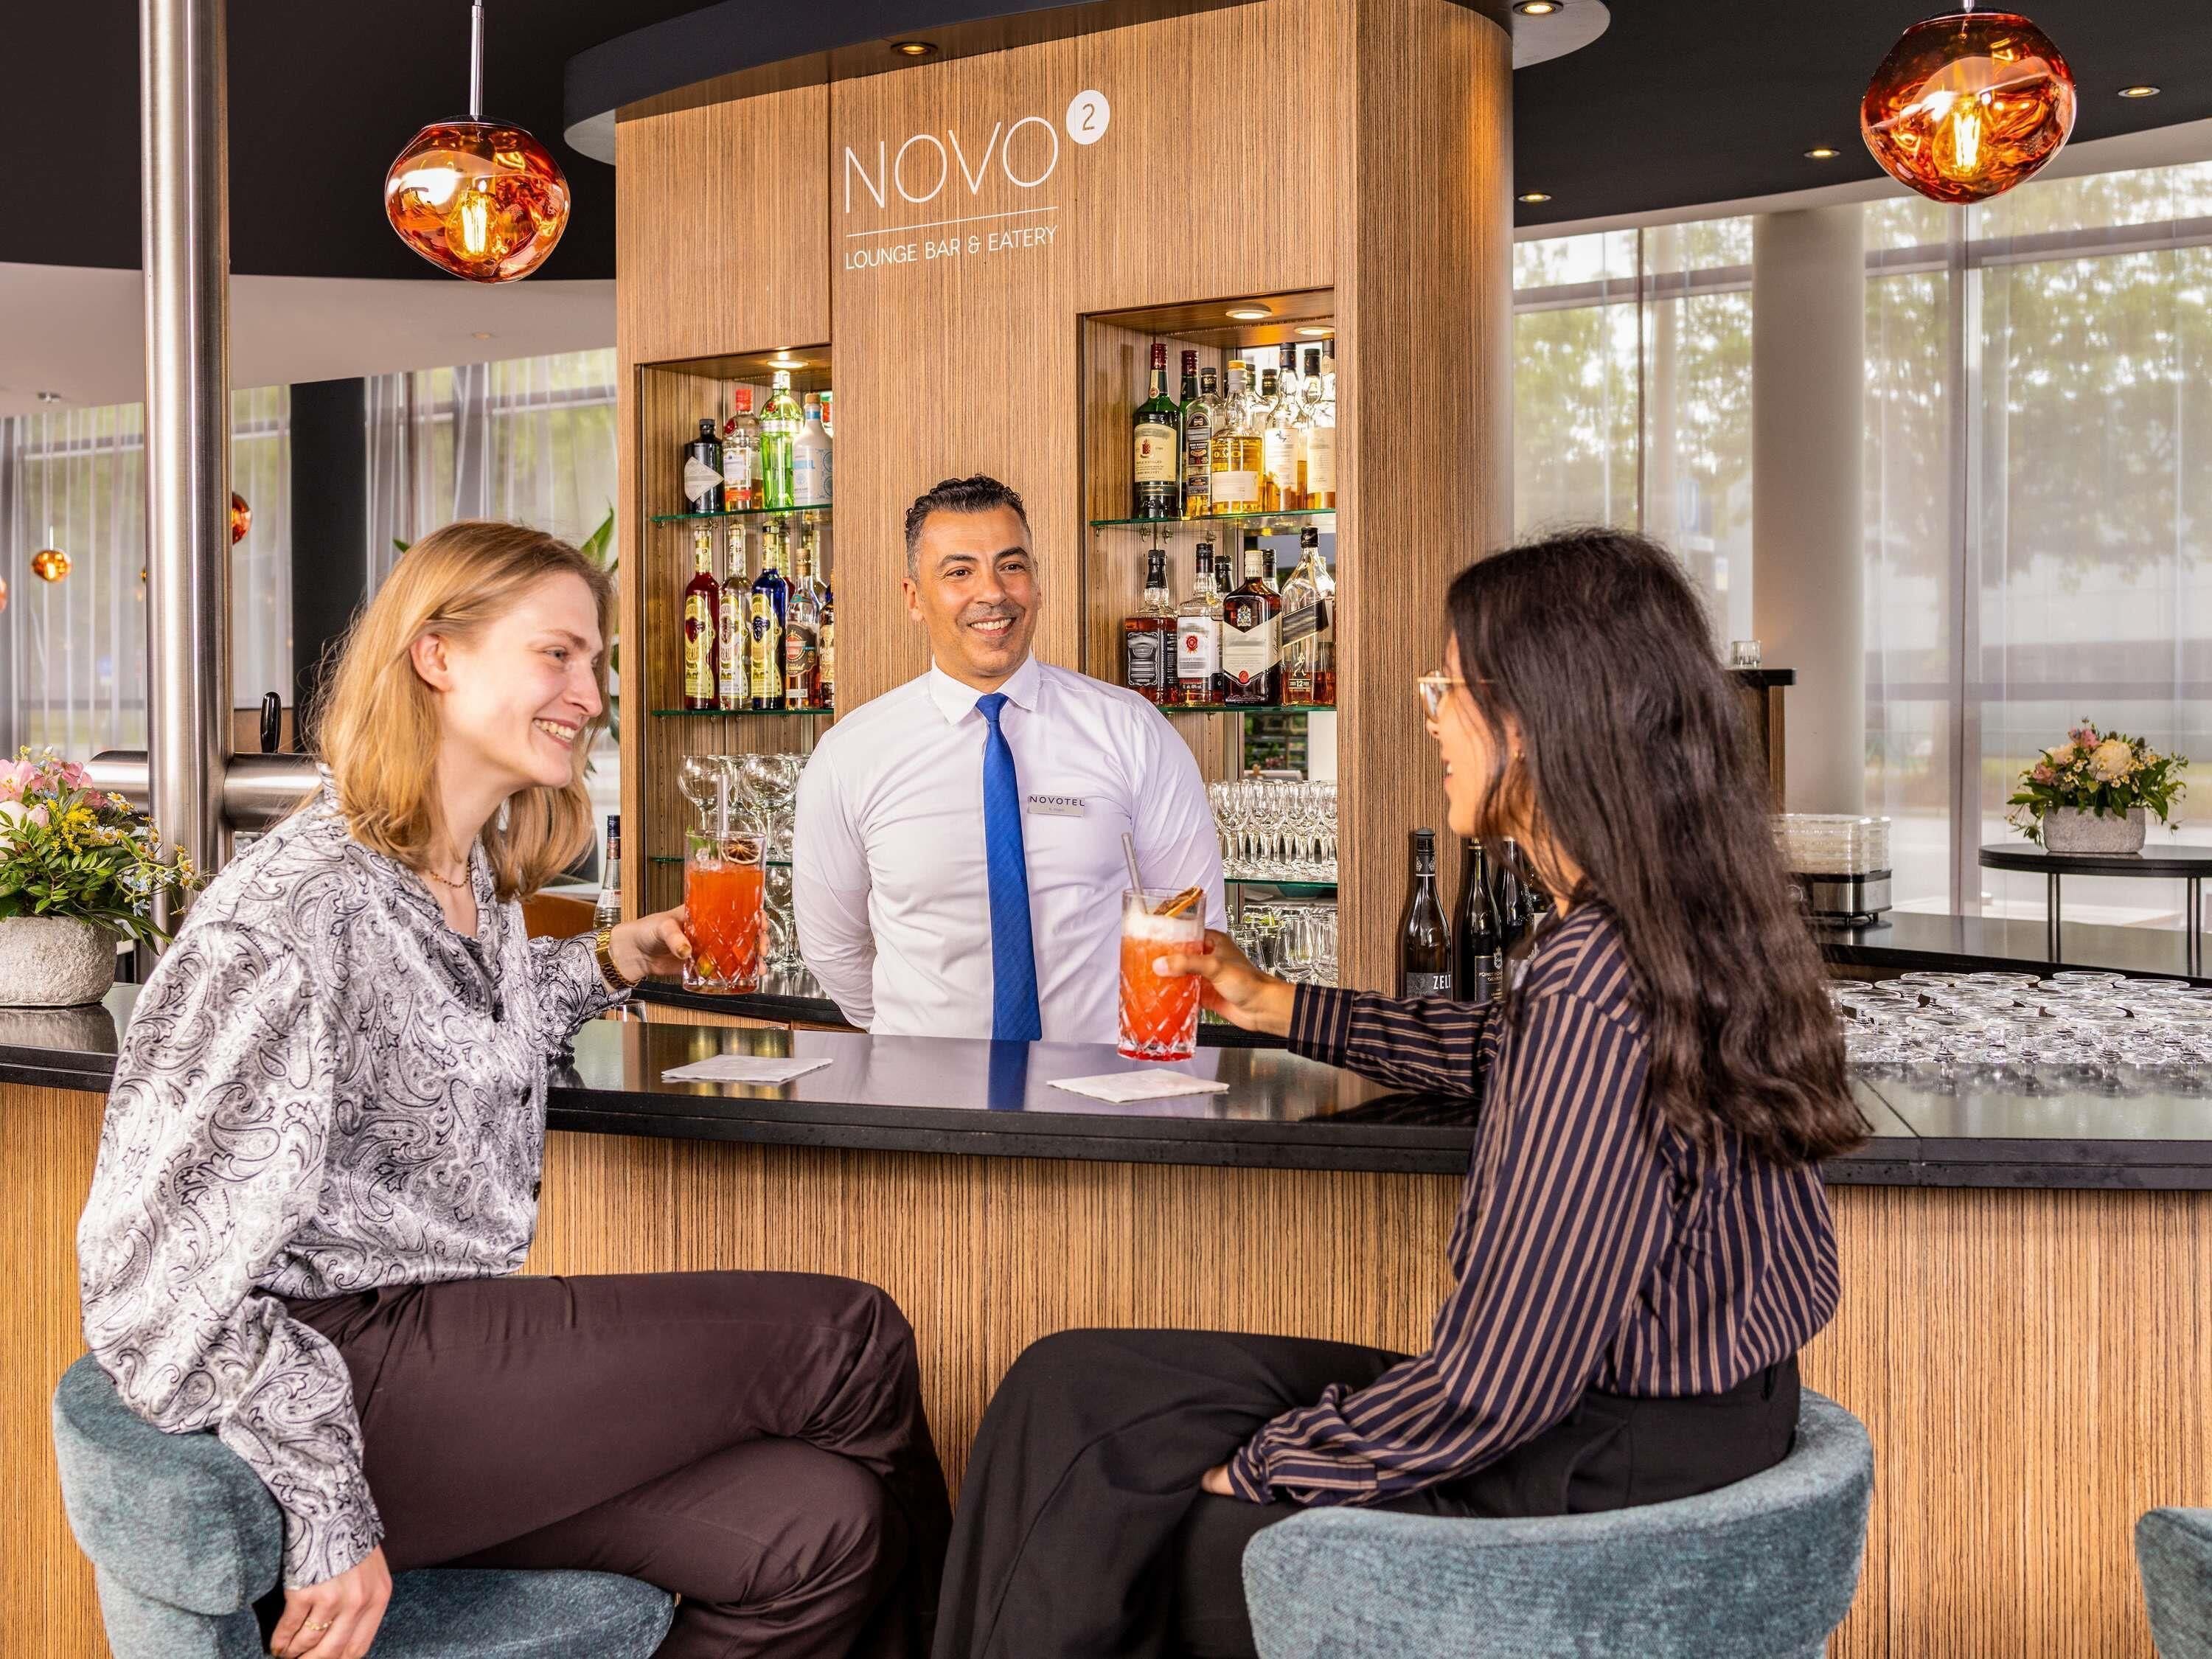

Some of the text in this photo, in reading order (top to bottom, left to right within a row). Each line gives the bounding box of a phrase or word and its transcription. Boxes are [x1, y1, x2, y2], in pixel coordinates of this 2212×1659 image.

[845, 102, 1096, 213] NOVO 2
[845, 225, 1058, 271] LOUNGE BAR & EATERY
[1029, 796, 1085, 807] NOVOTEL
